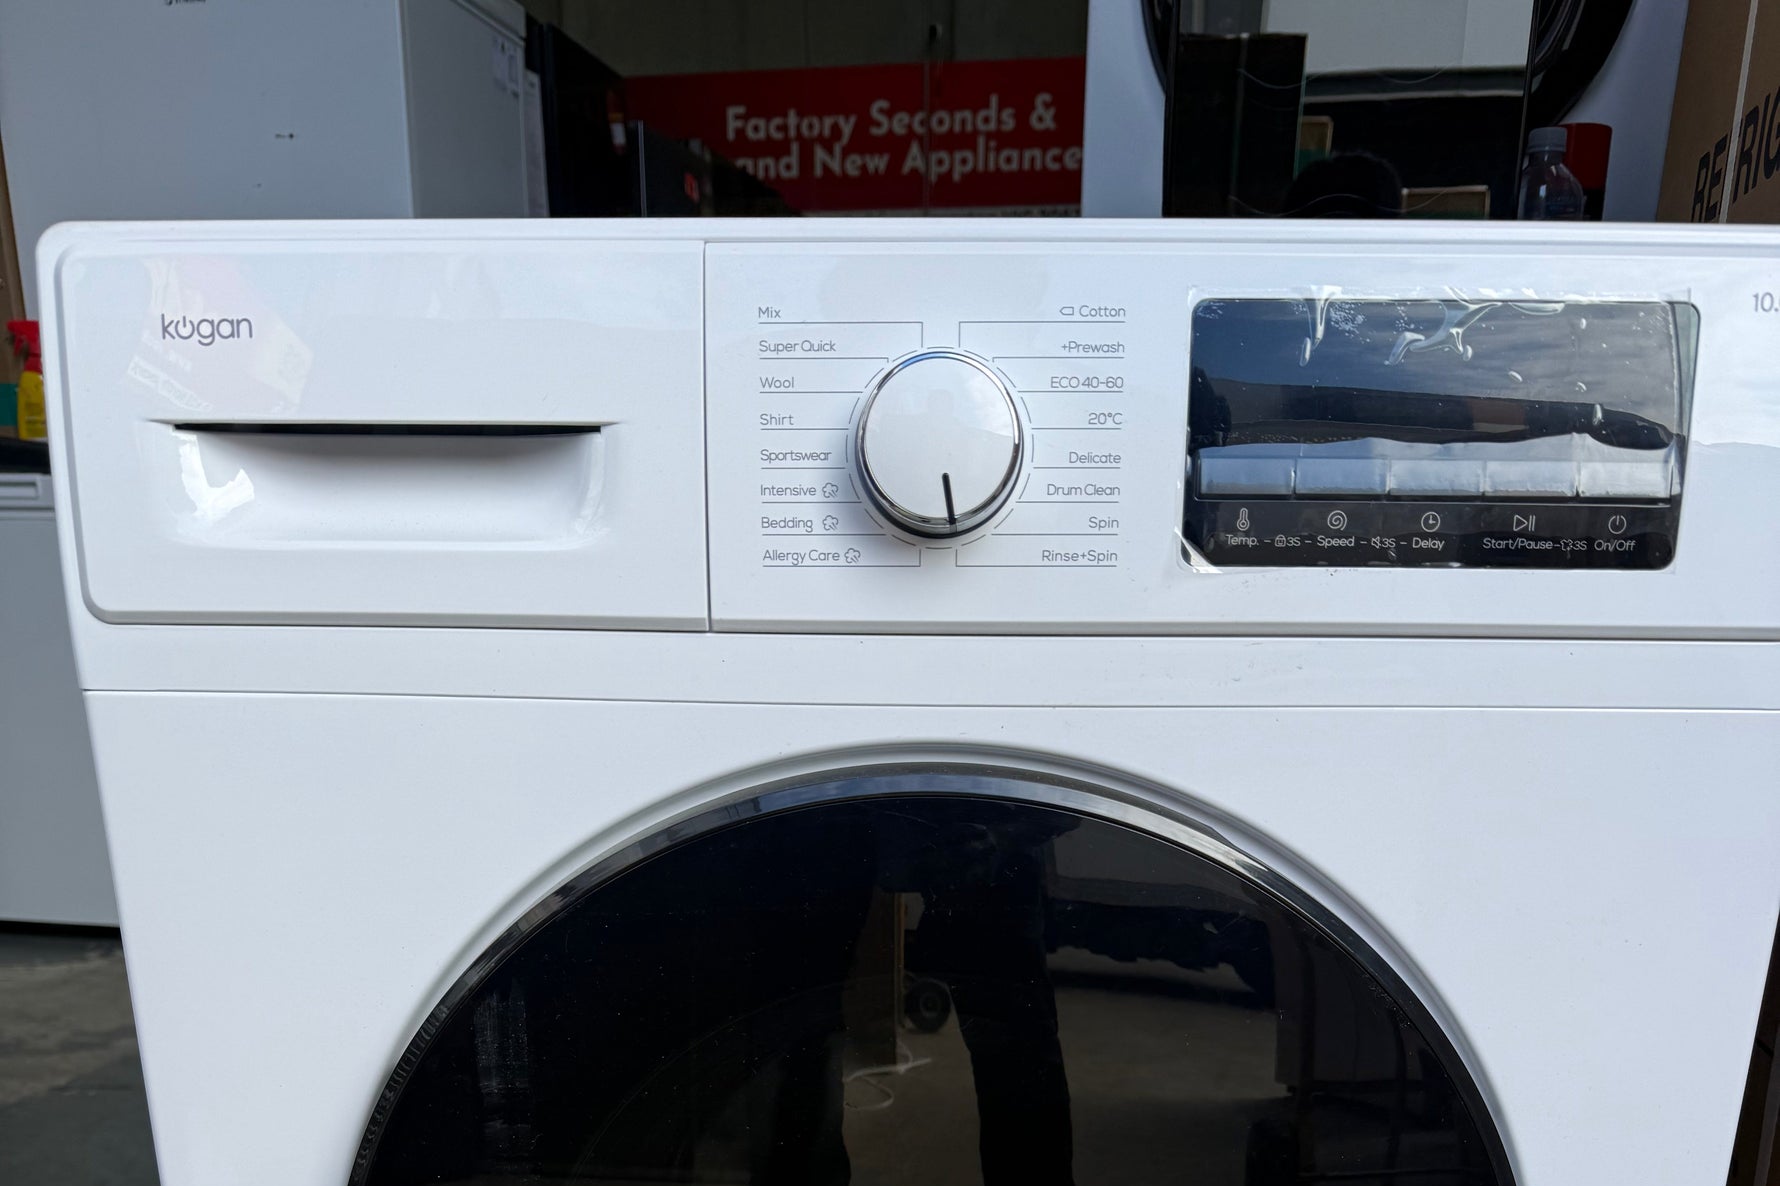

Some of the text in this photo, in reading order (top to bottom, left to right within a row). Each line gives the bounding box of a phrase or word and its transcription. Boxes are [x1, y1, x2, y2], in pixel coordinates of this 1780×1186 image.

[726, 91, 1056, 147] Factory Seconds &
[813, 142, 889, 179] New
[900, 135, 1082, 184] Appliance
[758, 307, 781, 318] Mix
[1079, 305, 1126, 317] Cotton
[160, 313, 253, 347] kogan
[759, 340, 836, 354] Super Quick
[1061, 341, 1125, 354] +Prewash
[759, 377, 794, 389] Wool
[1050, 377, 1124, 389] ECO 40-60
[759, 413, 794, 426] Shirt
[1088, 413, 1123, 425] 20°C
[760, 449, 832, 464] Sportswear
[1068, 451, 1121, 464] Delicate
[760, 484, 817, 497] Intensive
[761, 516, 813, 531] Bedding
[1088, 516, 1119, 531] Spin
[1226, 534, 1259, 548] Temp.
[1317, 536, 1355, 549] Speed
[1413, 537, 1445, 551] Delay
[1594, 539, 1636, 551] On/Off
[763, 549, 840, 565] Allergy Care
[1041, 549, 1118, 565] Rinse+Spin
